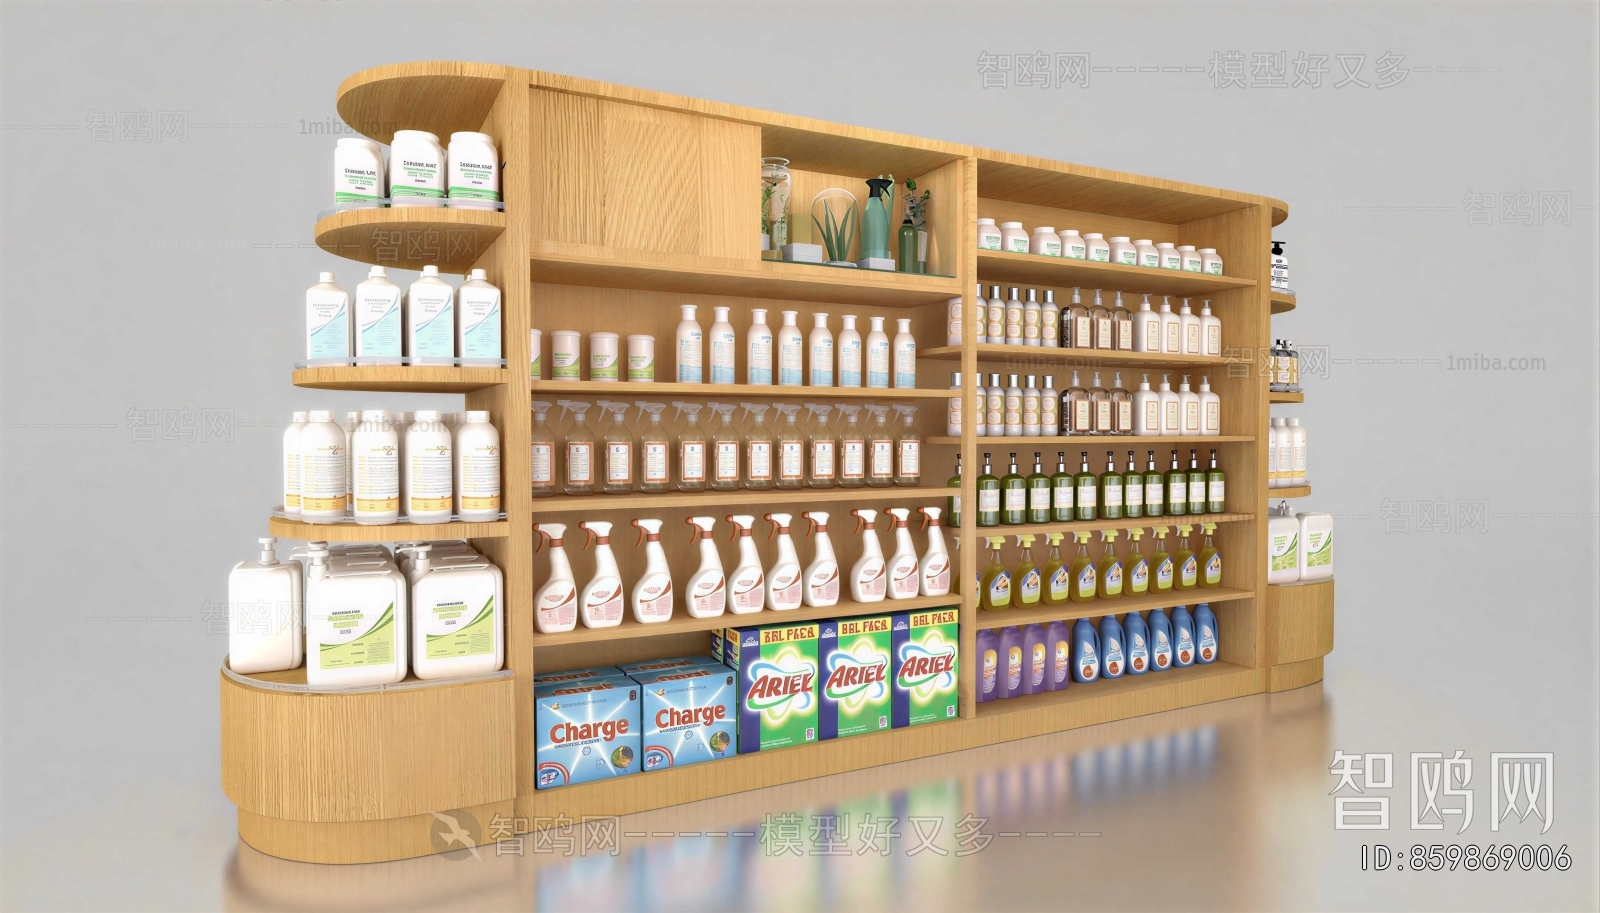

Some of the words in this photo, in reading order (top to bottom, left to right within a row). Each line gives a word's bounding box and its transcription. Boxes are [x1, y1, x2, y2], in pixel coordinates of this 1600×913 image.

[826, 660, 888, 689] ARIEL
[899, 651, 955, 679] ARIEL
[747, 672, 813, 700] ARIEL
[655, 704, 726, 729] Charge
[550, 718, 629, 744] Charge
